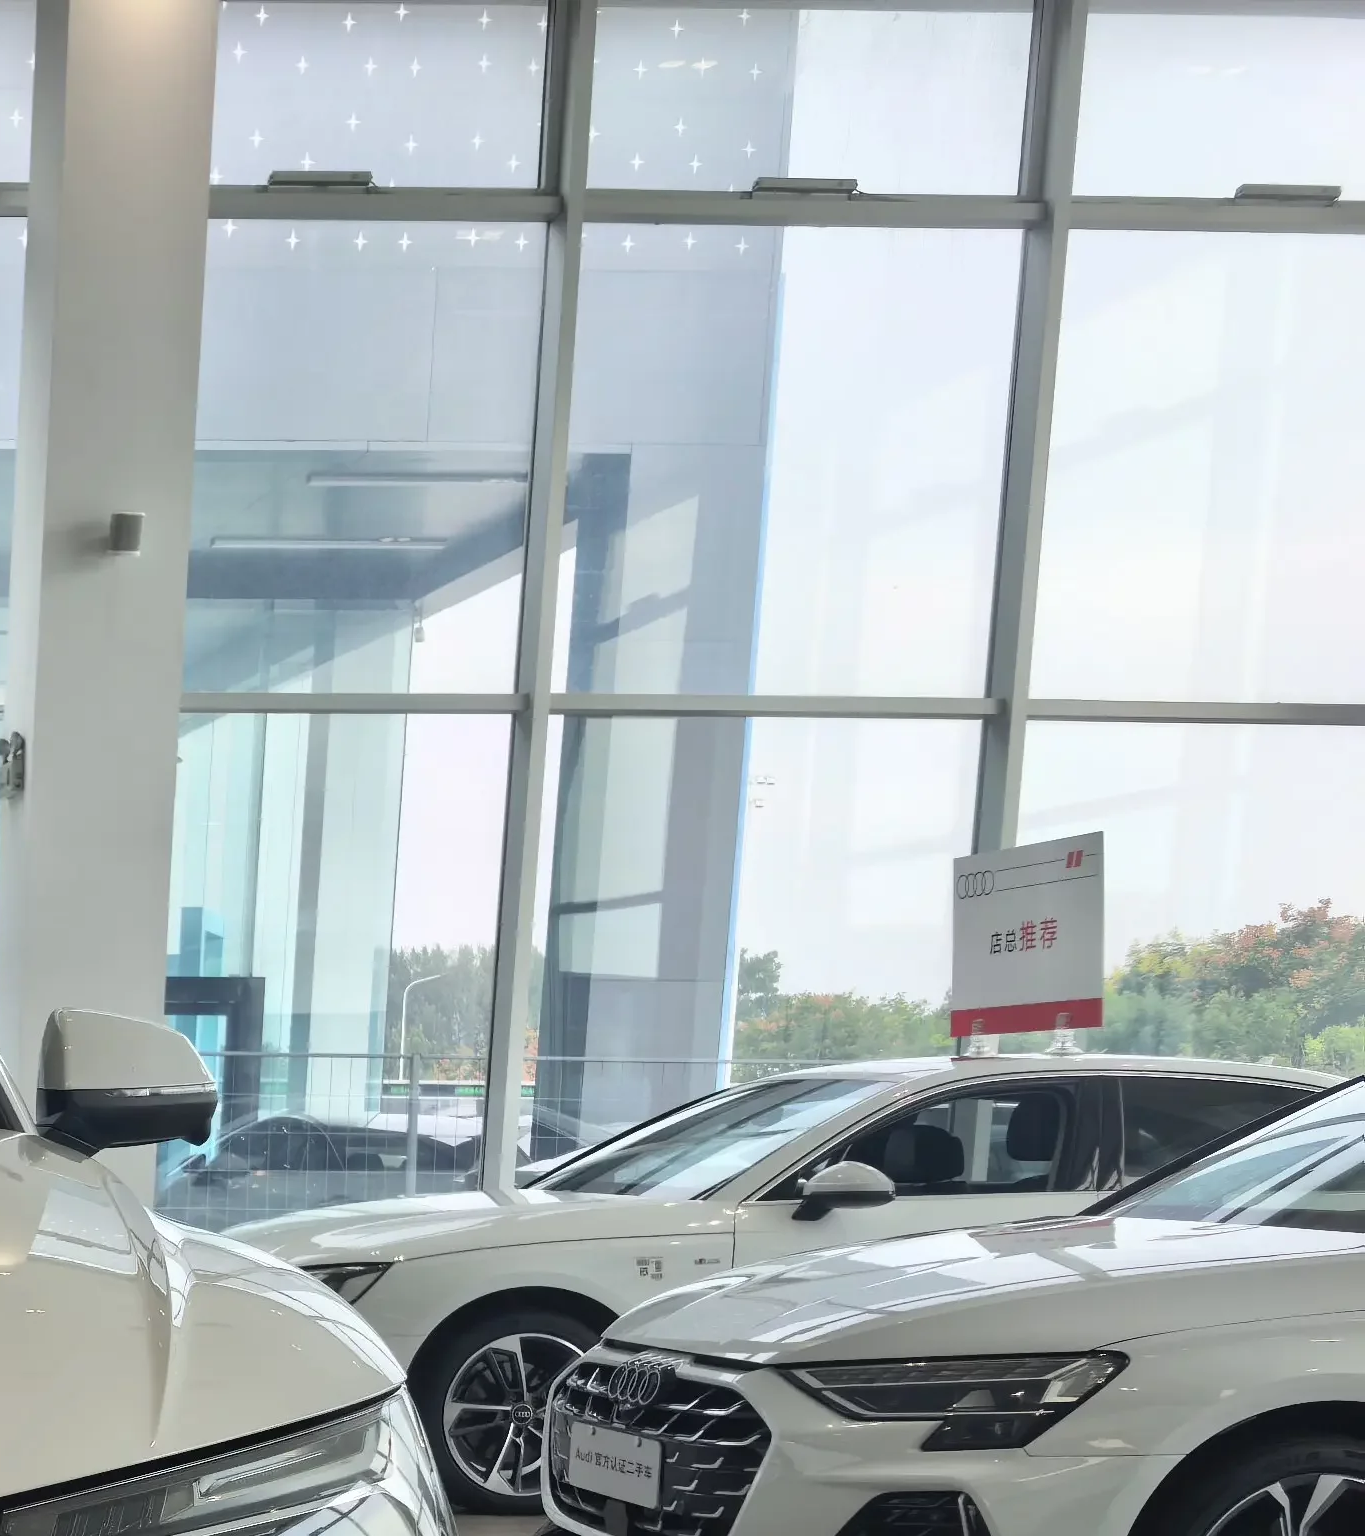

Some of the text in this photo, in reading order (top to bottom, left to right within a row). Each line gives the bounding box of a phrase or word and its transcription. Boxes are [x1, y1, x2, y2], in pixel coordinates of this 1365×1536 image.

[989, 916, 1058, 955] 店总推荐
[575, 1448, 653, 1479] Audi 官方认证二手车
